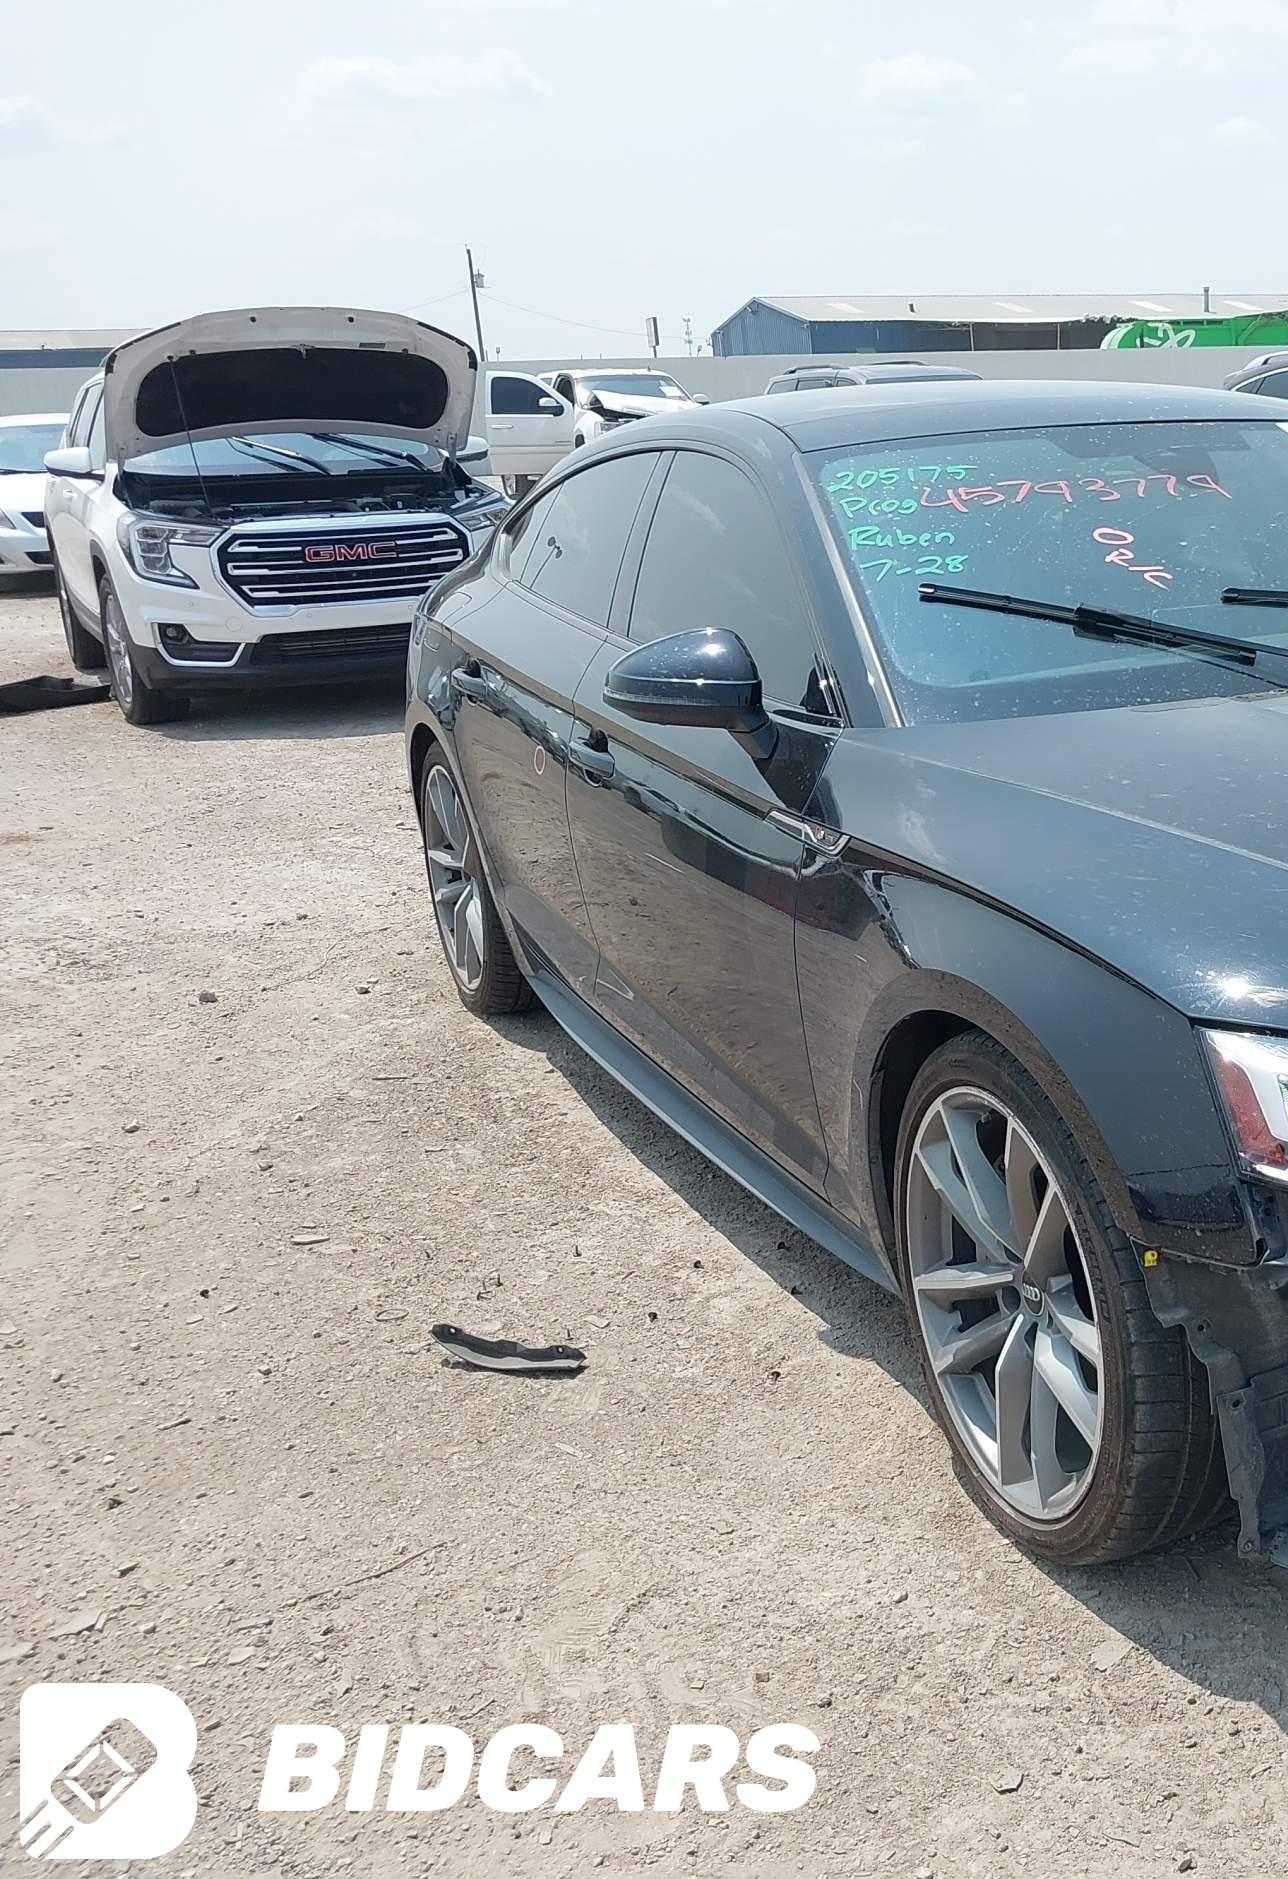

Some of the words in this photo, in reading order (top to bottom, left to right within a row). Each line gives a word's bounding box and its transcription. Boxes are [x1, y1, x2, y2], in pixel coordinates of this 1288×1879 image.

[827, 465, 978, 493] 205175
[919, 474, 1233, 513] 45793779
[305, 541, 397, 563] GMC
[848, 526, 956, 551] Ruben
[860, 555, 969, 582] 7-28
